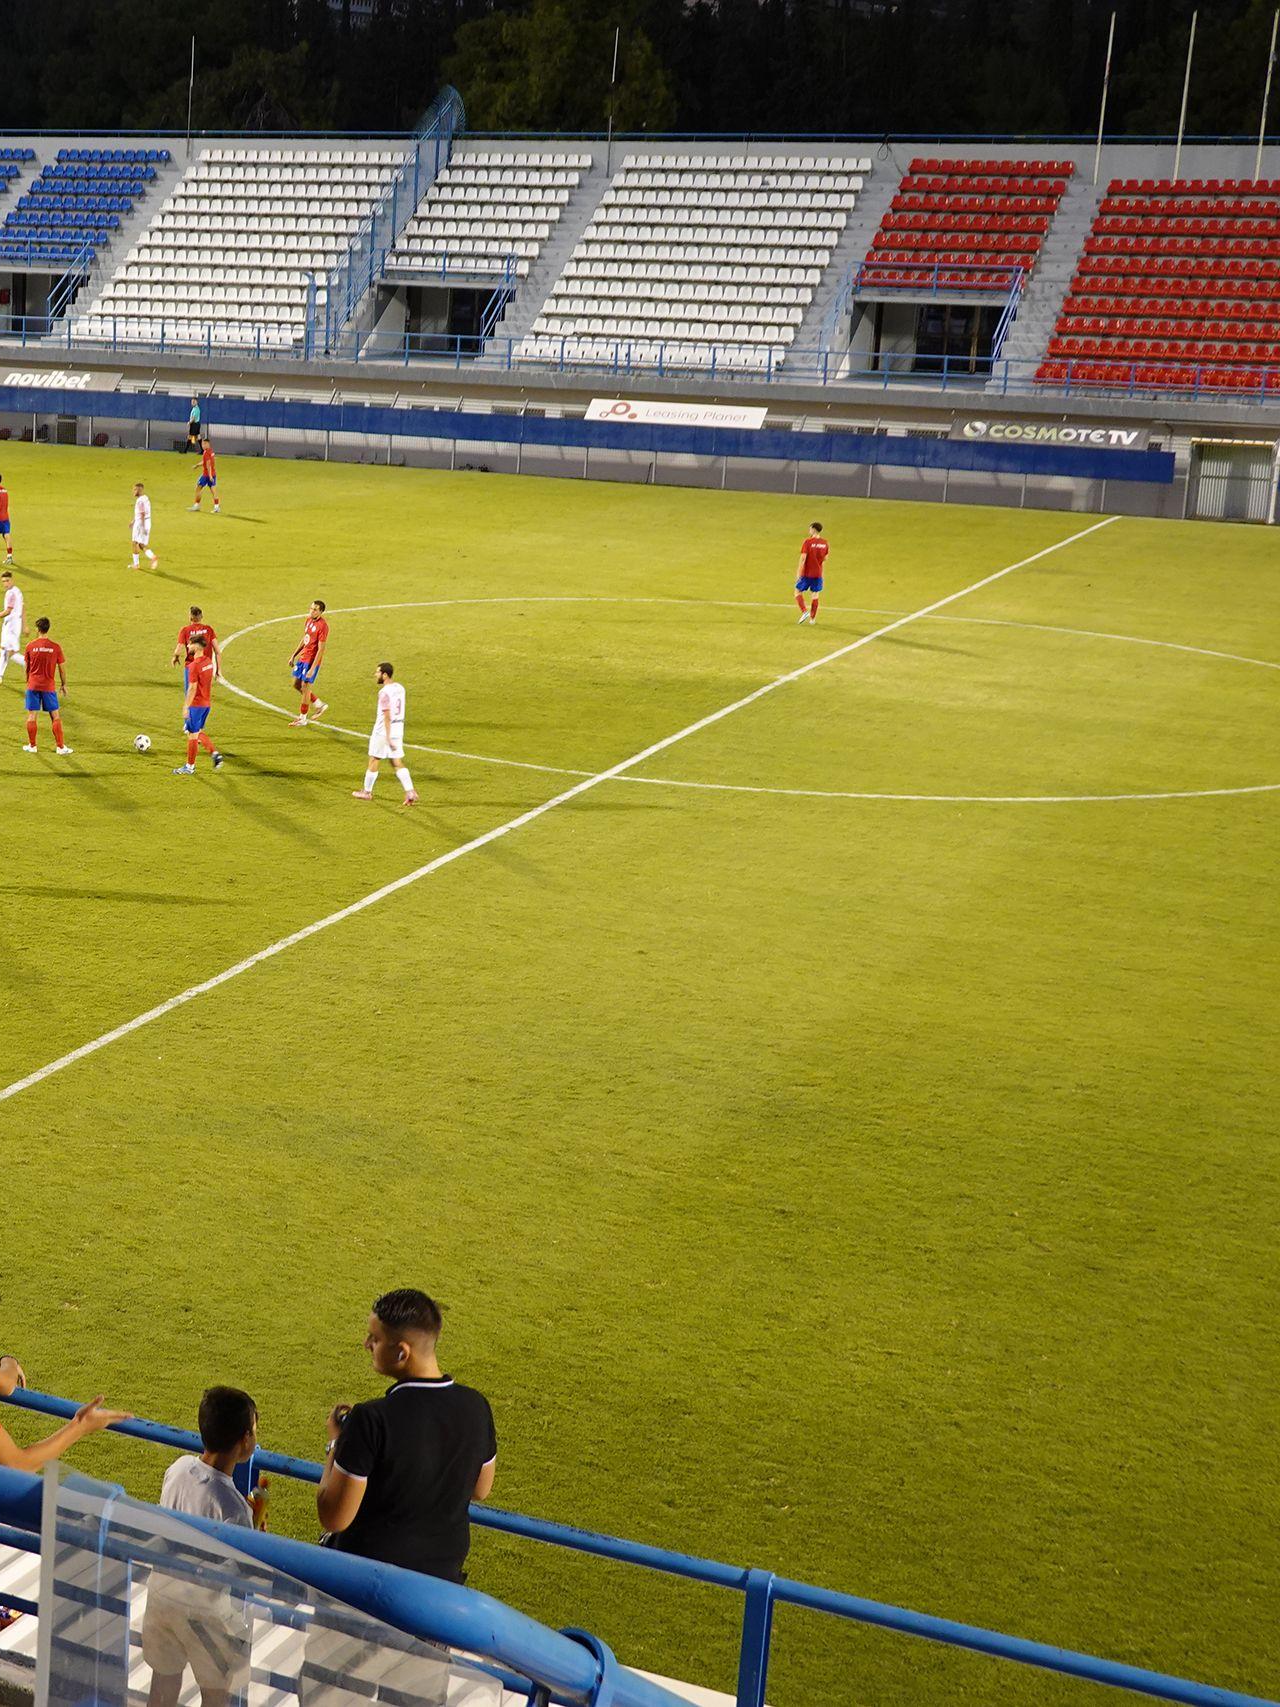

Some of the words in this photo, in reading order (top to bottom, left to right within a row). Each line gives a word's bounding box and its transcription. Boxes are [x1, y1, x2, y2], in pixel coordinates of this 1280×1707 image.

[3, 370, 91, 390] novibet
[645, 408, 699, 421] Leasing
[703, 411, 748, 423] Planet
